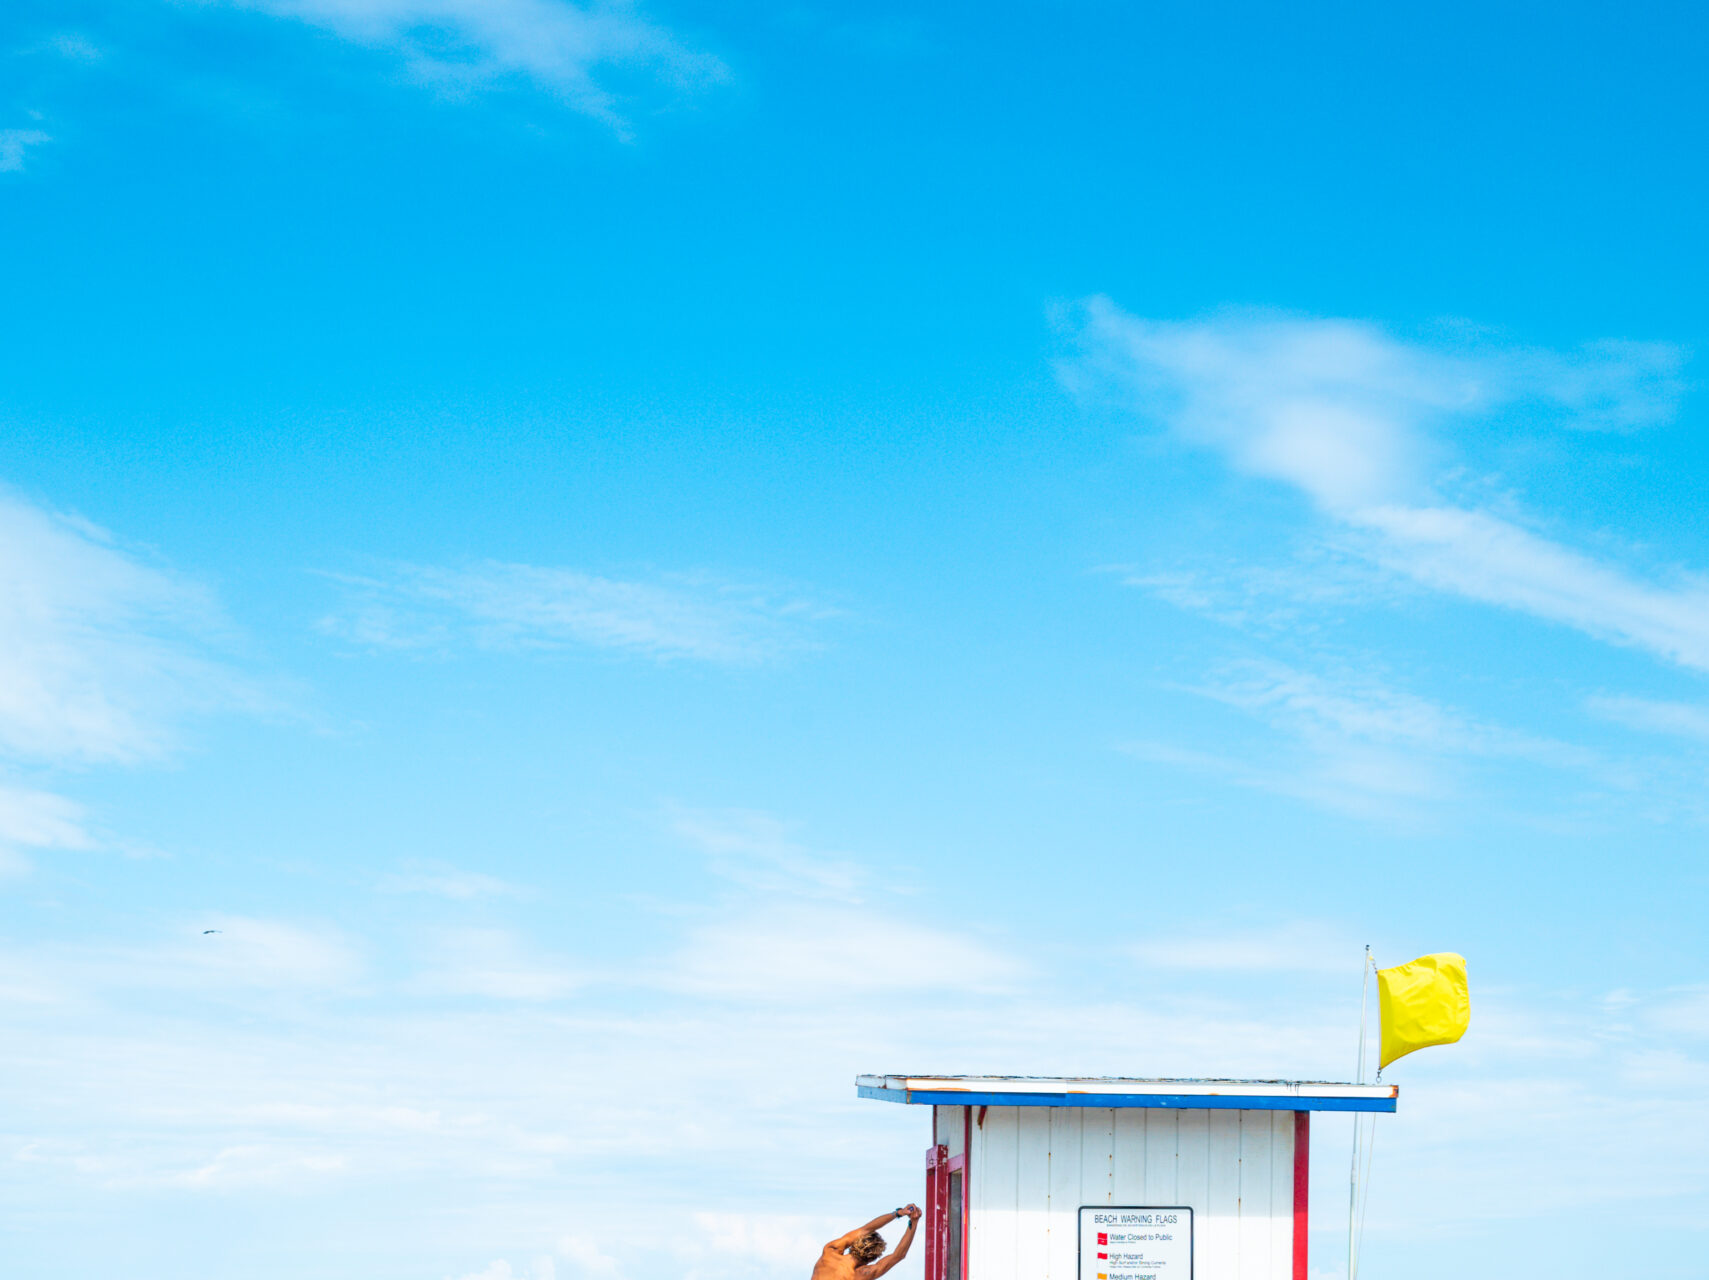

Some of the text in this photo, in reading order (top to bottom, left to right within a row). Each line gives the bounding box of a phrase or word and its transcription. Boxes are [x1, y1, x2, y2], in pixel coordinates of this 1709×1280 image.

[1094, 1215, 1177, 1223] BEACH WARNING FLAGS
[1110, 1253, 1121, 1261] High
